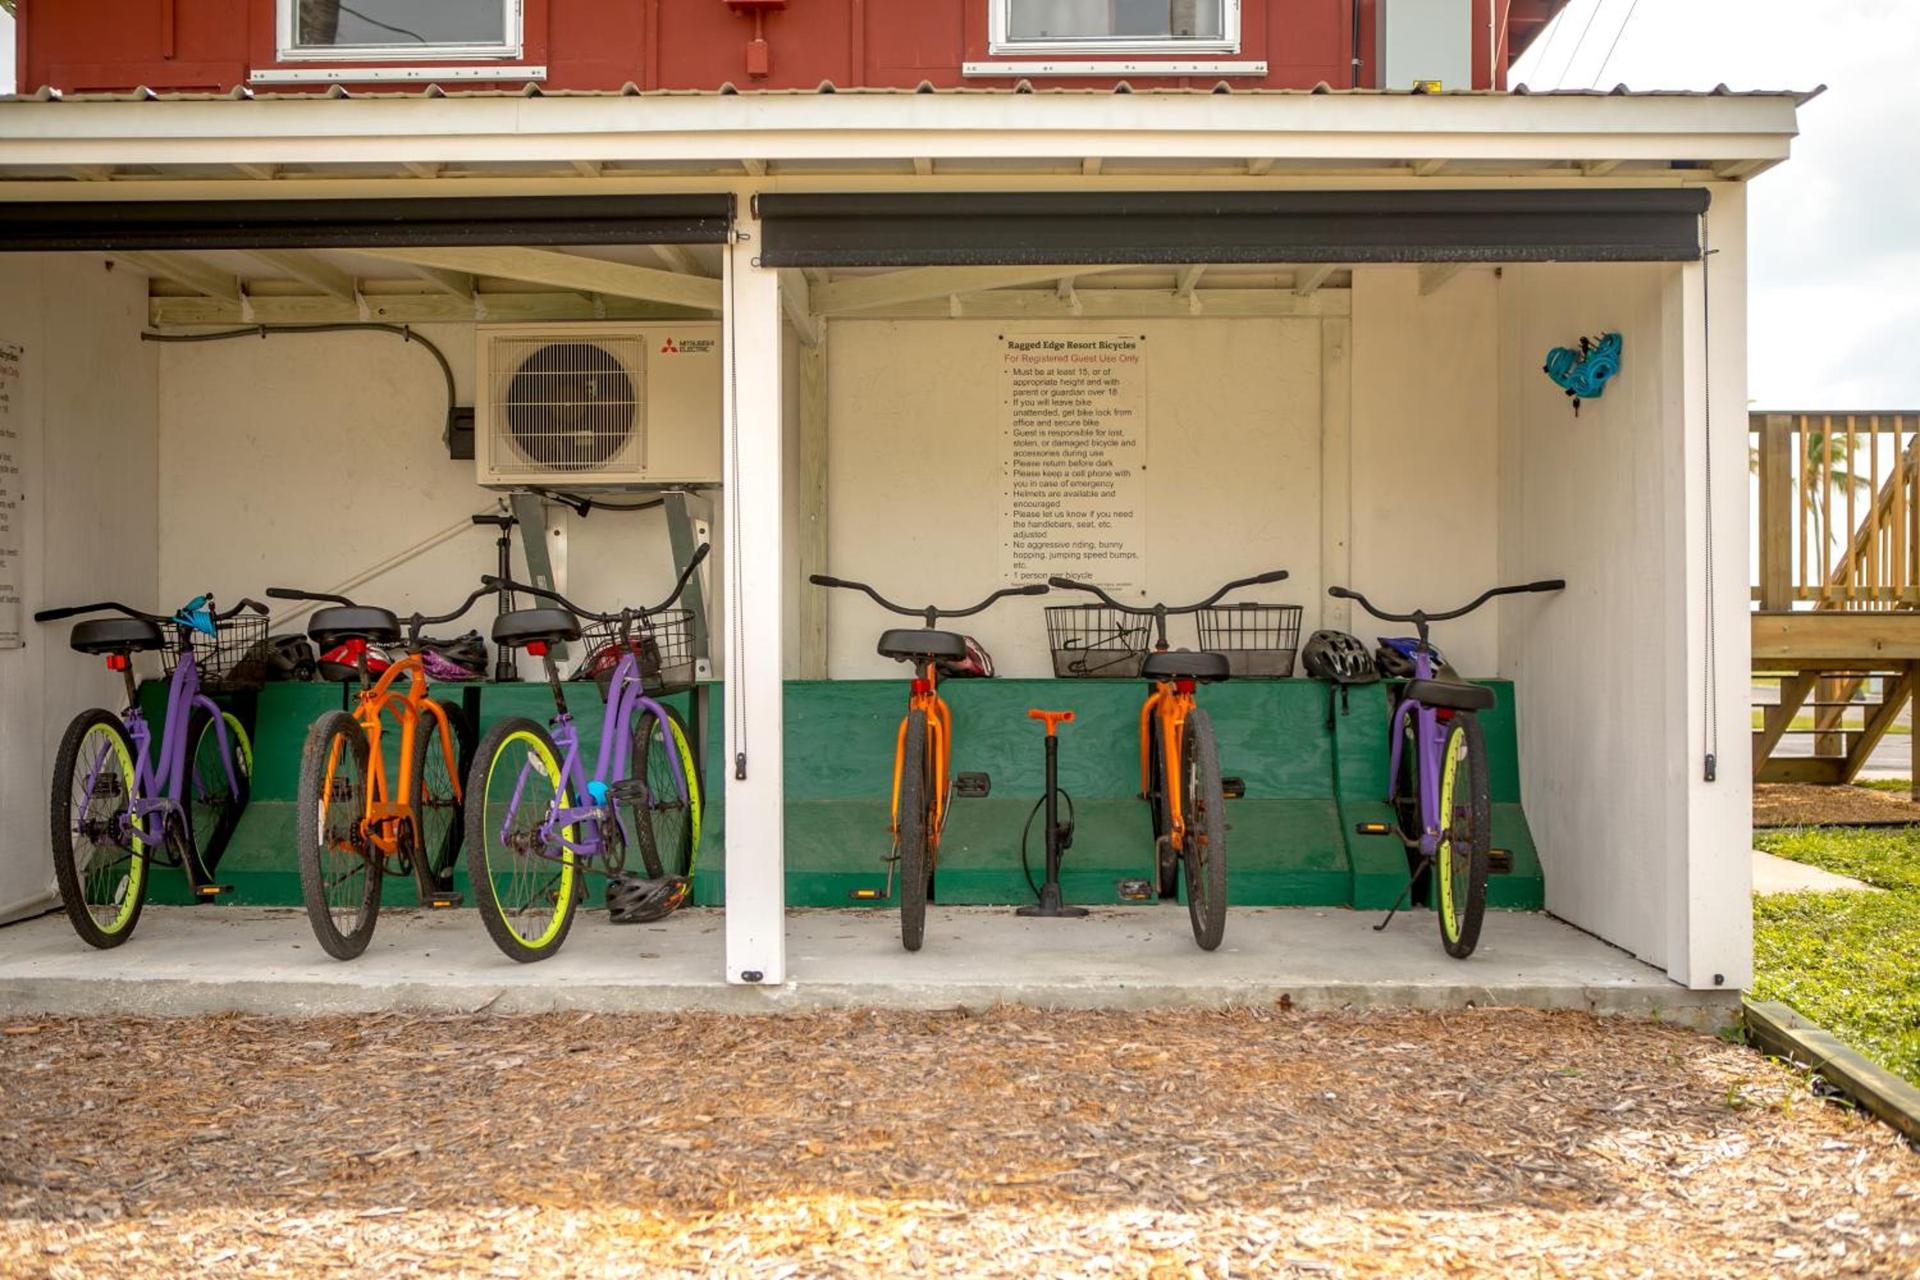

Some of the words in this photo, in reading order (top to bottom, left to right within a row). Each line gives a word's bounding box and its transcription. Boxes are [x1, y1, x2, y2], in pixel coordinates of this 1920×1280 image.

[1007, 340, 1041, 351] Ragged
[1042, 340, 1065, 351] Edge
[1067, 340, 1097, 349] Resort
[1099, 340, 1136, 351] Bicycles
[1004, 354, 1018, 362] For
[1021, 354, 1068, 365] Registered
[1071, 354, 1097, 362] Guest
[1099, 354, 1117, 362] Use
[1119, 354, 1140, 365] Only
[1013, 367, 1033, 376] Must
[1034, 367, 1045, 376] be
[1047, 367, 1054, 376] at
[1057, 367, 1076, 376] least
[1103, 367, 1111, 376] of
[1013, 378, 1058, 388] appropriate
[1060, 378, 1085, 388] height
[1087, 378, 1102, 386] and
[1103, 378, 1120, 386] with
[1013, 388, 1039, 398] parent
[1050, 388, 1086, 398] guardian
[1013, 398, 1018, 406] If
[1020, 400, 1035, 408] you
[1037, 398, 1050, 406] will
[1051, 398, 1074, 406] leave
[1075, 398, 1093, 406] bike
[1062, 408, 1075, 419] get
[1077, 408, 1094, 417] bike
[1096, 408, 1112, 417] lock
[1114, 408, 1133, 417] from
[1012, 418, 1034, 427] office
[1036, 418, 1052, 427] and
[1083, 418, 1100, 427] bike
[1013, 428, 1037, 437] Guest
[1039, 428, 1046, 437] is
[1048, 428, 1094, 439] responsible
[1096, 428, 1107, 437] for
[1051, 438, 1090, 449] damaged
[1091, 438, 1120, 449] bicycle
[1121, 438, 1137, 447] and
[1013, 449, 1060, 457] accessories
[1062, 449, 1088, 459] during
[1013, 459, 1040, 467] Please
[1043, 459, 1066, 467] return
[1068, 459, 1094, 467] before
[1096, 459, 1113, 467] dark
[1013, 469, 1041, 477] Please
[1043, 469, 1062, 479] keep
[1072, 469, 1086, 477] cell
[1088, 469, 1113, 479] phone
[1115, 469, 1132, 477] with
[1013, 481, 1028, 489] you
[1030, 479, 1037, 487] in
[1061, 479, 1069, 487] of
[1070, 481, 1114, 489] emergency
[1013, 489, 1046, 498] Helmets
[1063, 489, 1099, 498] available
[1101, 489, 1116, 498] and
[1013, 499, 1061, 510] encouraged
[1013, 509, 1041, 518] Please
[1042, 509, 1053, 518] let
[1066, 509, 1088, 518] know
[1090, 509, 1095, 518] if
[1097, 511, 1112, 520] you
[1113, 509, 1134, 518] need
[1013, 520, 1026, 528] the
[1013, 530, 1048, 540] adjusted
[1013, 540, 1025, 549] No
[1027, 540, 1070, 551] aggressive
[1099, 540, 1124, 551] bunny
[1049, 550, 1081, 561] jumping
[1083, 550, 1108, 561] speed
[1020, 572, 1048, 581] person
[1066, 571, 1093, 581] bicycle
